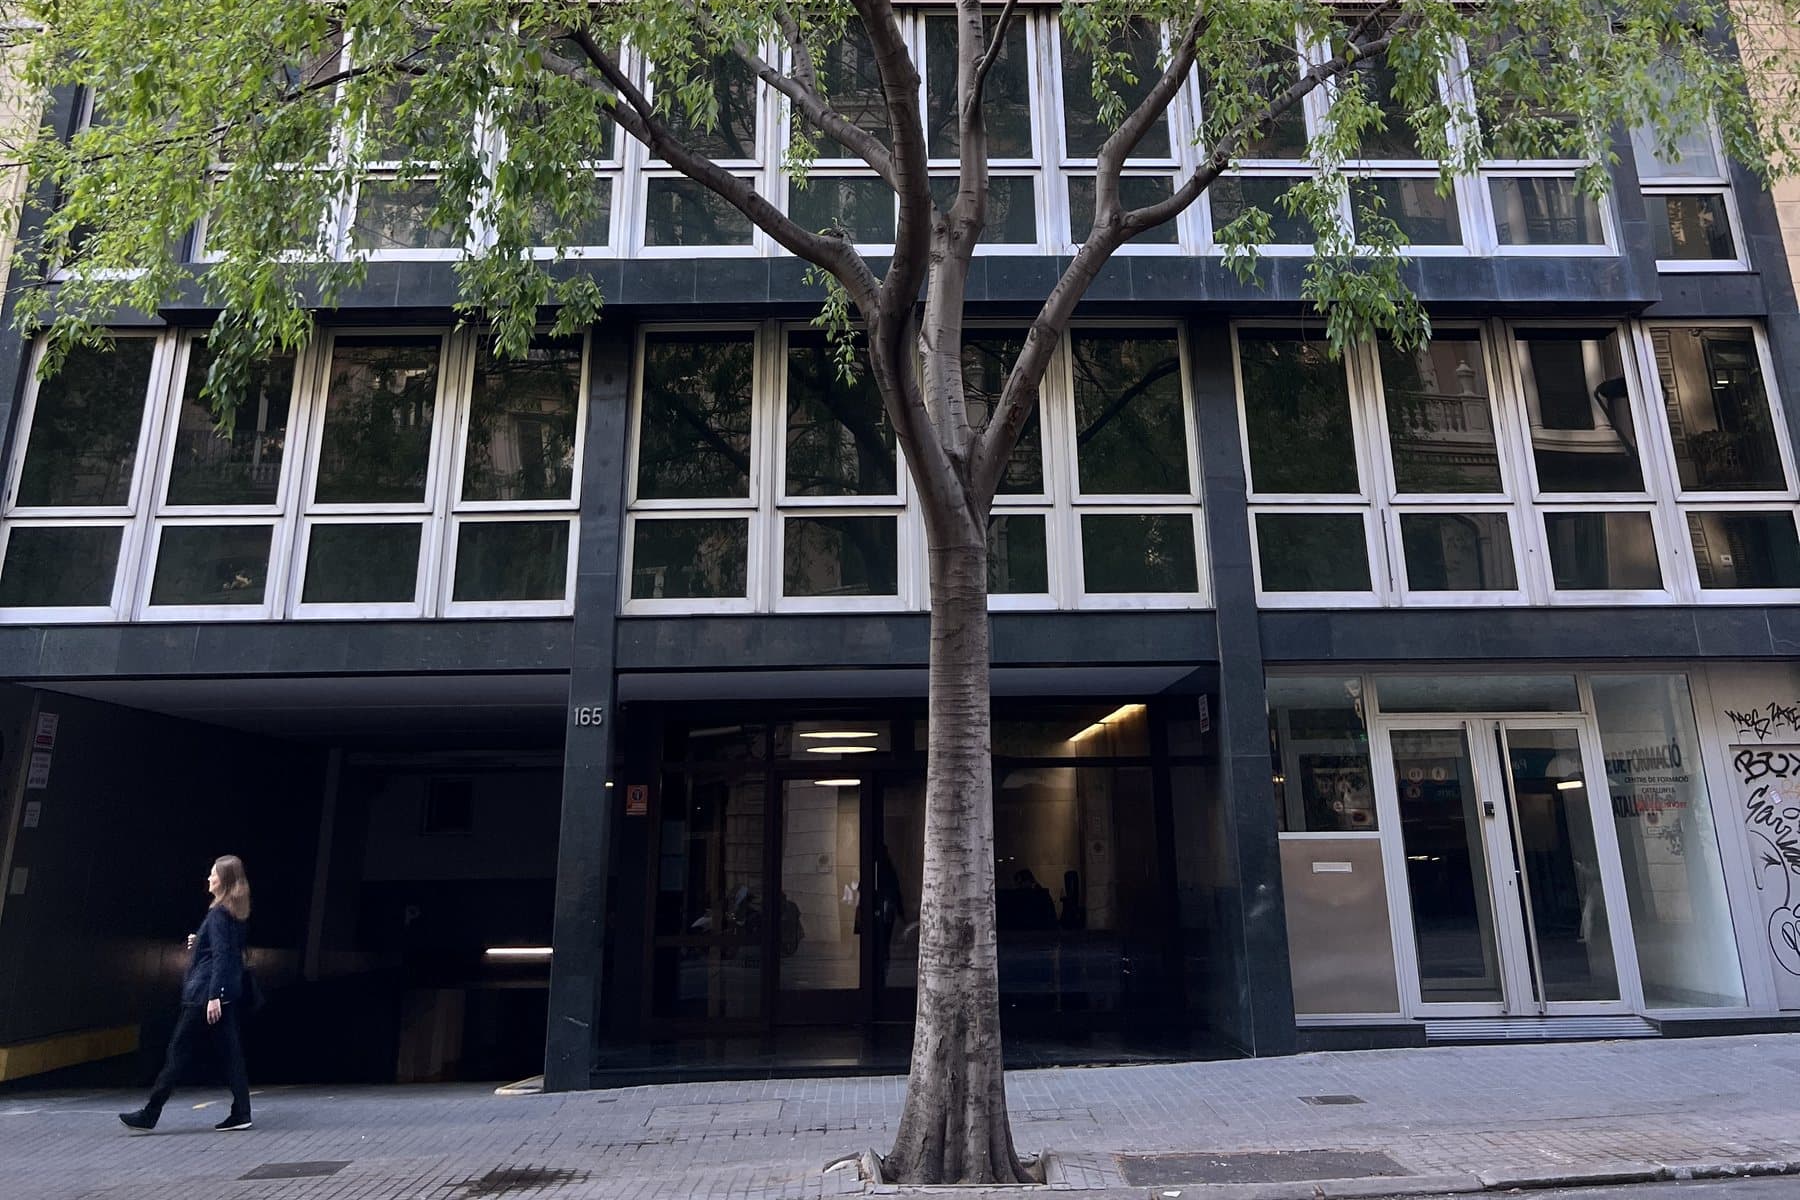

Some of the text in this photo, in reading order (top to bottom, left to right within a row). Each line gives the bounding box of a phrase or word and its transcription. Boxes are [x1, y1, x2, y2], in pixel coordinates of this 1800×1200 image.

[574, 707, 602, 726] 165
[1625, 736, 1682, 774] FORMACIÓ
[1624, 775, 1689, 784] CENTRE DE FORMACIÓ
[1642, 786, 1676, 794] CATALUNYA
